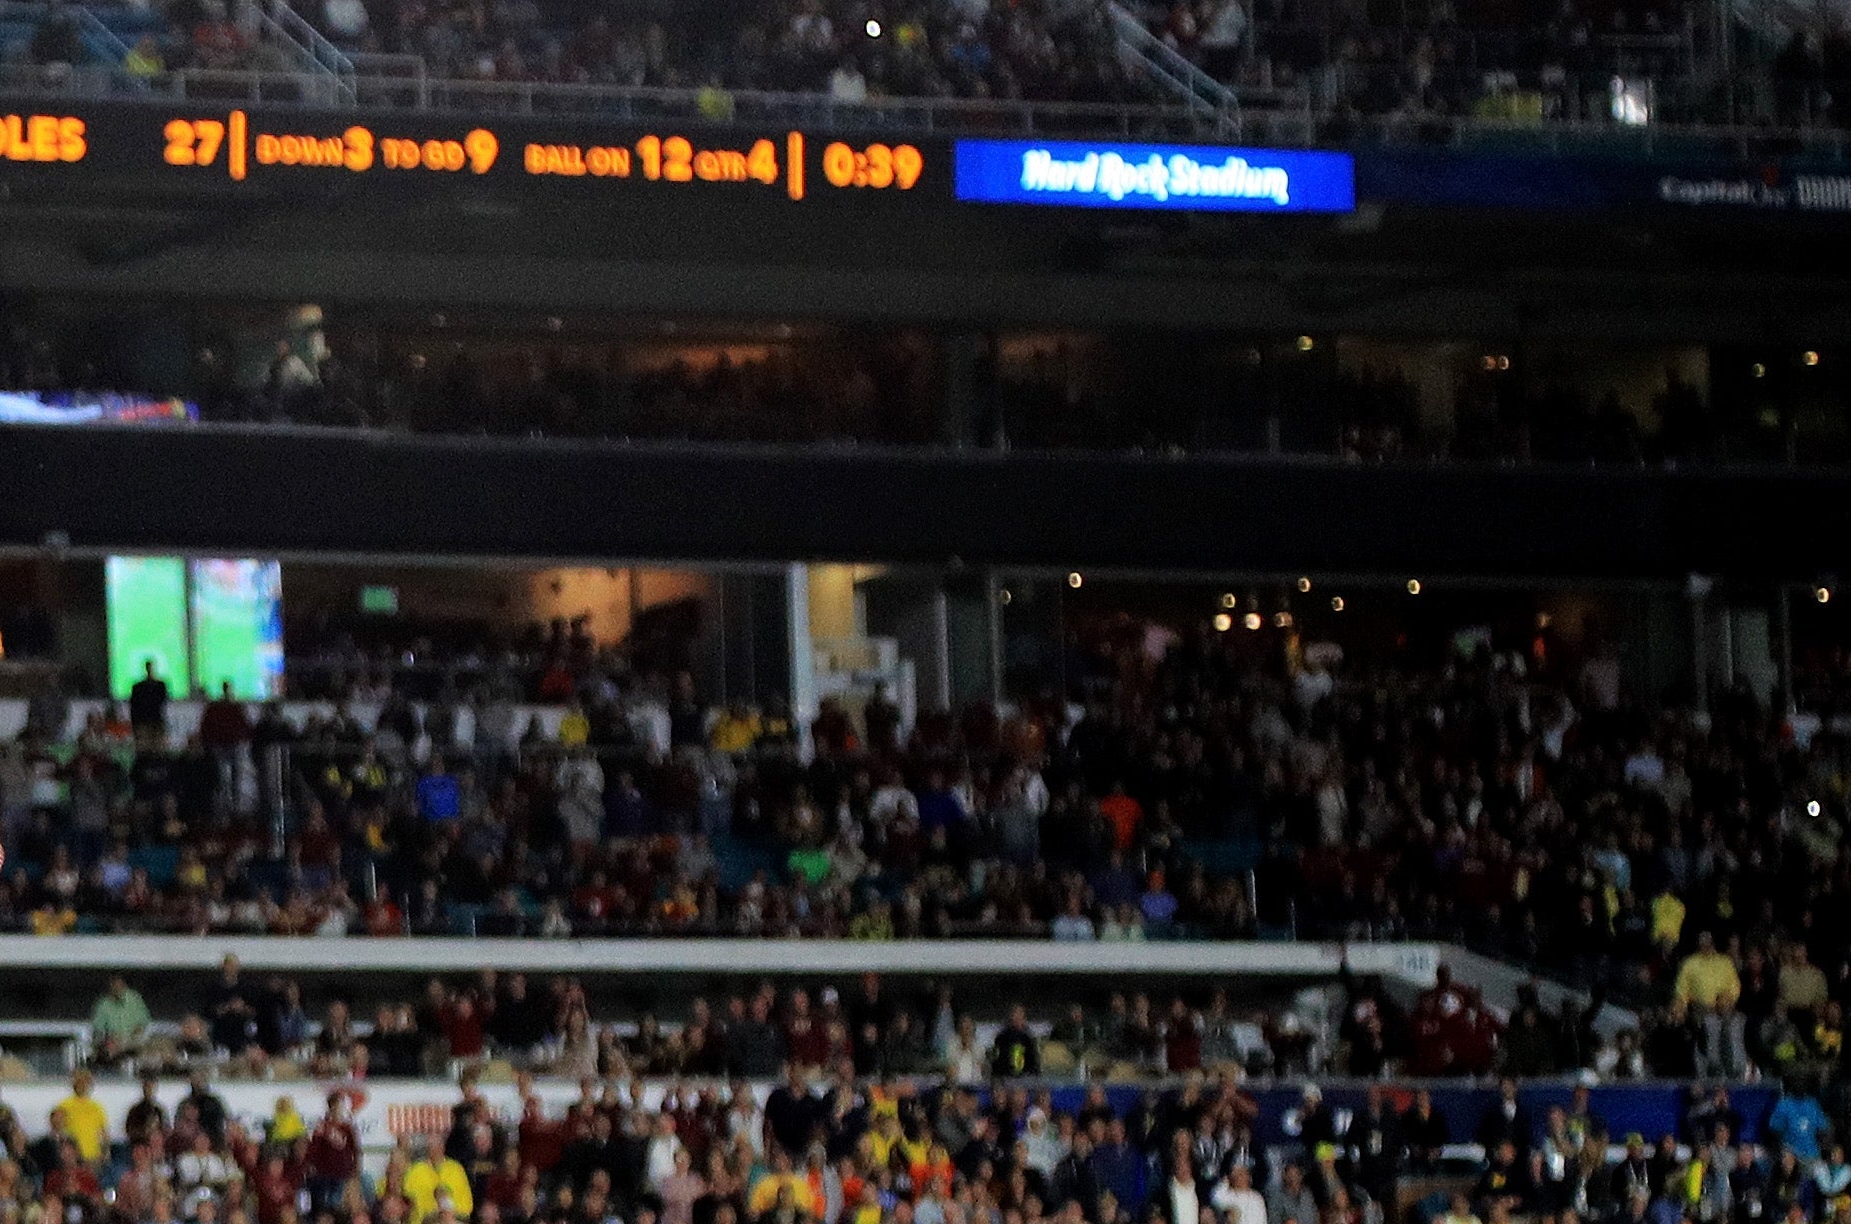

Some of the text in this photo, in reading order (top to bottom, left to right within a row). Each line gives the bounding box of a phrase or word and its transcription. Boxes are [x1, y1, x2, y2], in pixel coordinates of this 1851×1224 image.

[164, 119, 225, 166] 27
[382, 138, 421, 169] TO
[464, 128, 499, 174] 9
[524, 143, 587, 176] BALL
[585, 145, 631, 178] ON
[636, 135, 693, 182] 12
[823, 141, 924, 191] 0:39
[1022, 149, 1289, 206] Hard Rock Stadium
